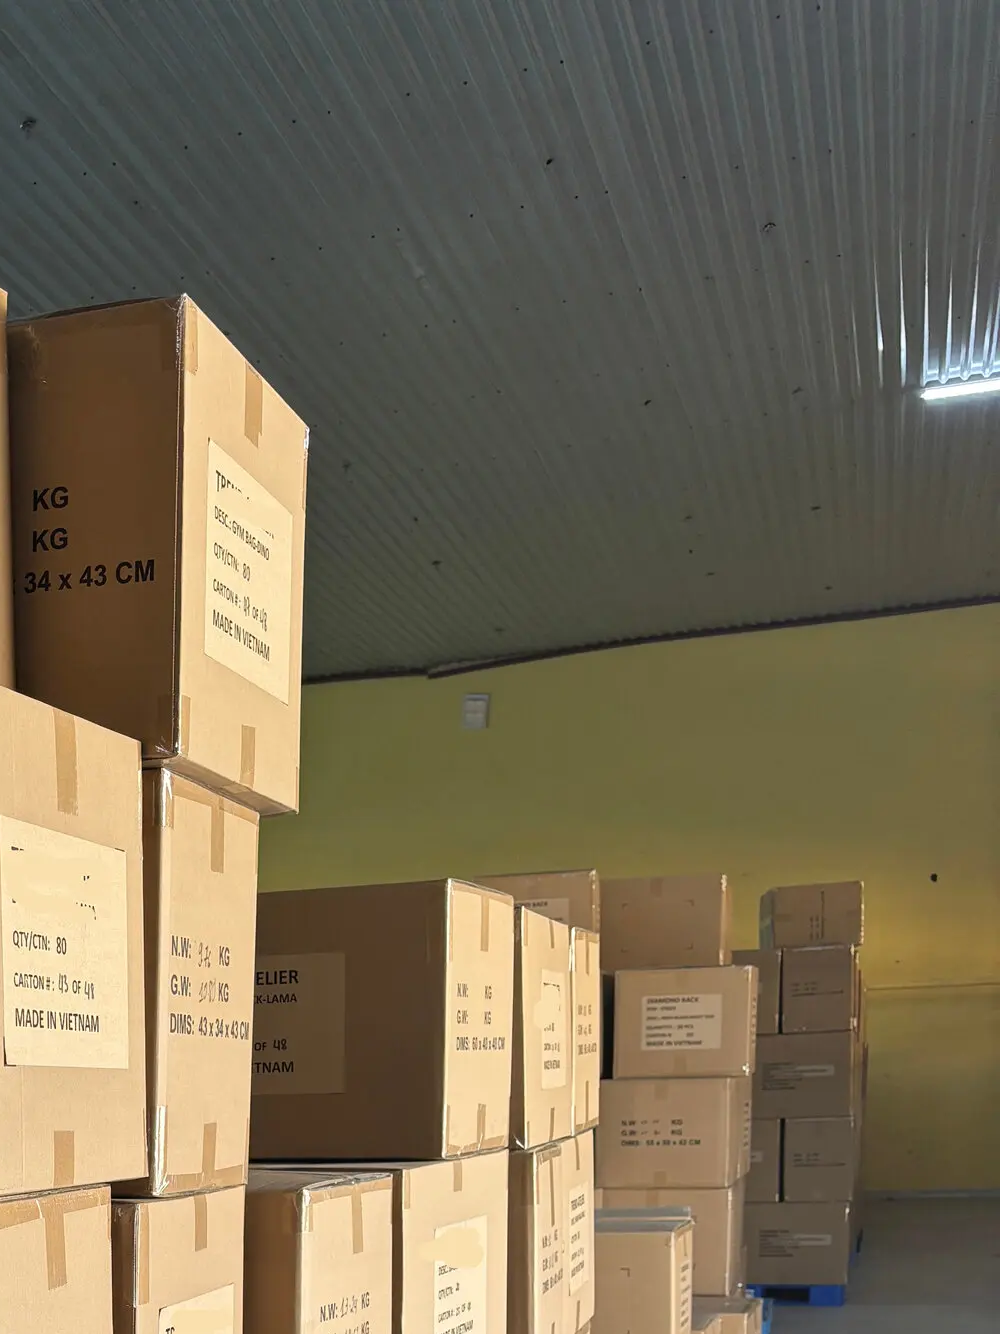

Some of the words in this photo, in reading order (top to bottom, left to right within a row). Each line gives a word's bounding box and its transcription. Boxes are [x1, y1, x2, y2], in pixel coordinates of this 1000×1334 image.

[32, 486, 69, 512] KG
[31, 527, 68, 552] KG
[232, 520, 245, 542] GYM
[245, 530, 270, 561] BAG-DINO
[24, 571, 51, 594] 34
[80, 564, 107, 587] 43
[115, 559, 155, 584] CM
[214, 542, 240, 573] QTY/CTN:
[242, 563, 250, 582] 80
[213, 609, 233, 637] MADE
[235, 620, 241, 642] IN
[243, 628, 270, 661] VIETNAM
[12, 931, 50, 951] QTY/CTN:
[56, 936, 67, 955] 80
[15, 1008, 44, 1028] MADE
[47, 1012, 56, 1029] IN
[59, 1013, 100, 1033] VIETNAM
[273, 1038, 287, 1051] 48
[320, 1303, 338, 1323] N.W:
[361, 1291, 370, 1309] KG
